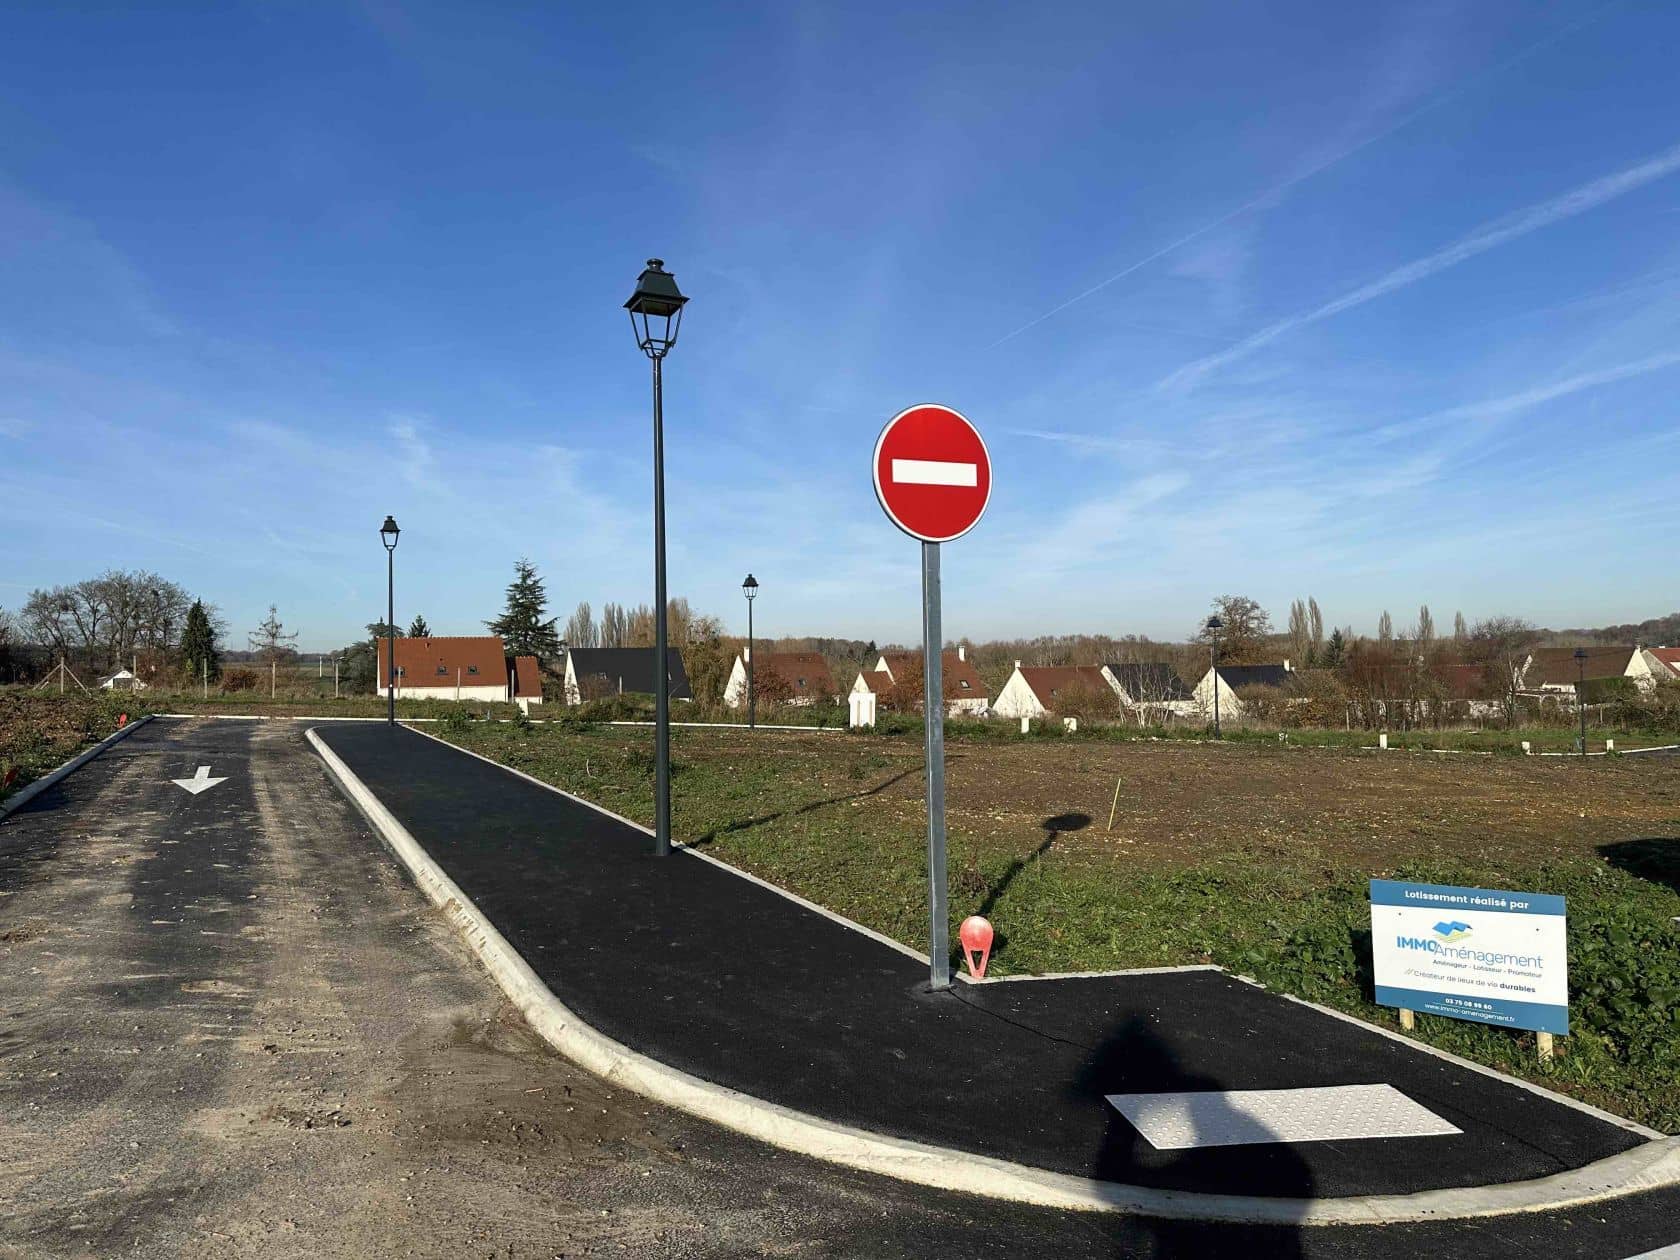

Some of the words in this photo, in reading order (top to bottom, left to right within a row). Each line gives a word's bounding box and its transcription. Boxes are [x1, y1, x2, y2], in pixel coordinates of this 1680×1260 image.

[1405, 890, 1468, 904] Lotissement
[1470, 896, 1506, 907] réalisé
[1510, 901, 1528, 910] par
[1432, 960, 1468, 969] Aménageur
[1473, 965, 1502, 973] Lotisseur
[1508, 968, 1542, 978] Promoteur
[1500, 983, 1536, 992] durables
